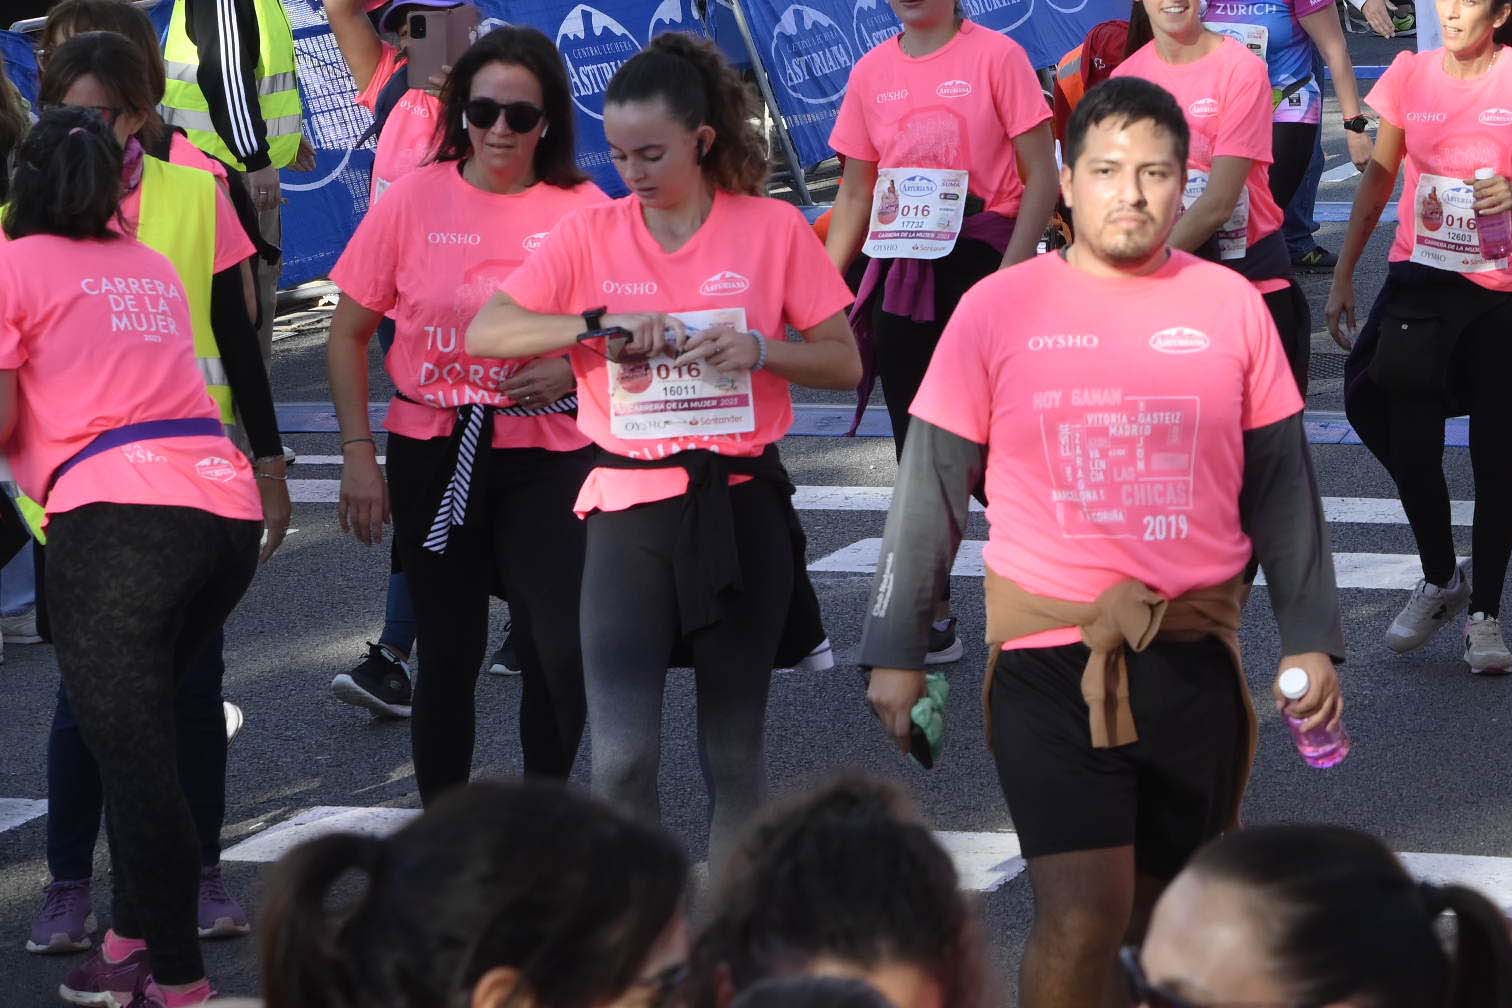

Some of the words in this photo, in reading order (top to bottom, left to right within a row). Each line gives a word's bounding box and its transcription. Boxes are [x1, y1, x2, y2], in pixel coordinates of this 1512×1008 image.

[1215, 2, 1277, 17] ZURICH
[1406, 111, 1447, 123] OYSHO
[901, 205, 931, 217] 016
[1445, 214, 1476, 230] 016
[427, 232, 481, 245] OYSHO
[1447, 231, 1472, 243] 12603
[81, 277, 183, 302] CARRERA
[601, 279, 657, 295] OYSHO
[109, 294, 137, 312] DE
[146, 296, 170, 314] LA
[111, 314, 178, 335] MUJER
[423, 325, 457, 353] TU
[1027, 334, 1099, 352] OYSHO
[656, 361, 701, 380] 016
[662, 385, 697, 397] 16011
[700, 414, 743, 427] Santander
[1086, 413, 1129, 425] VITORIA
[1109, 424, 1152, 437] MADRID
[1143, 514, 1189, 541] 2019
